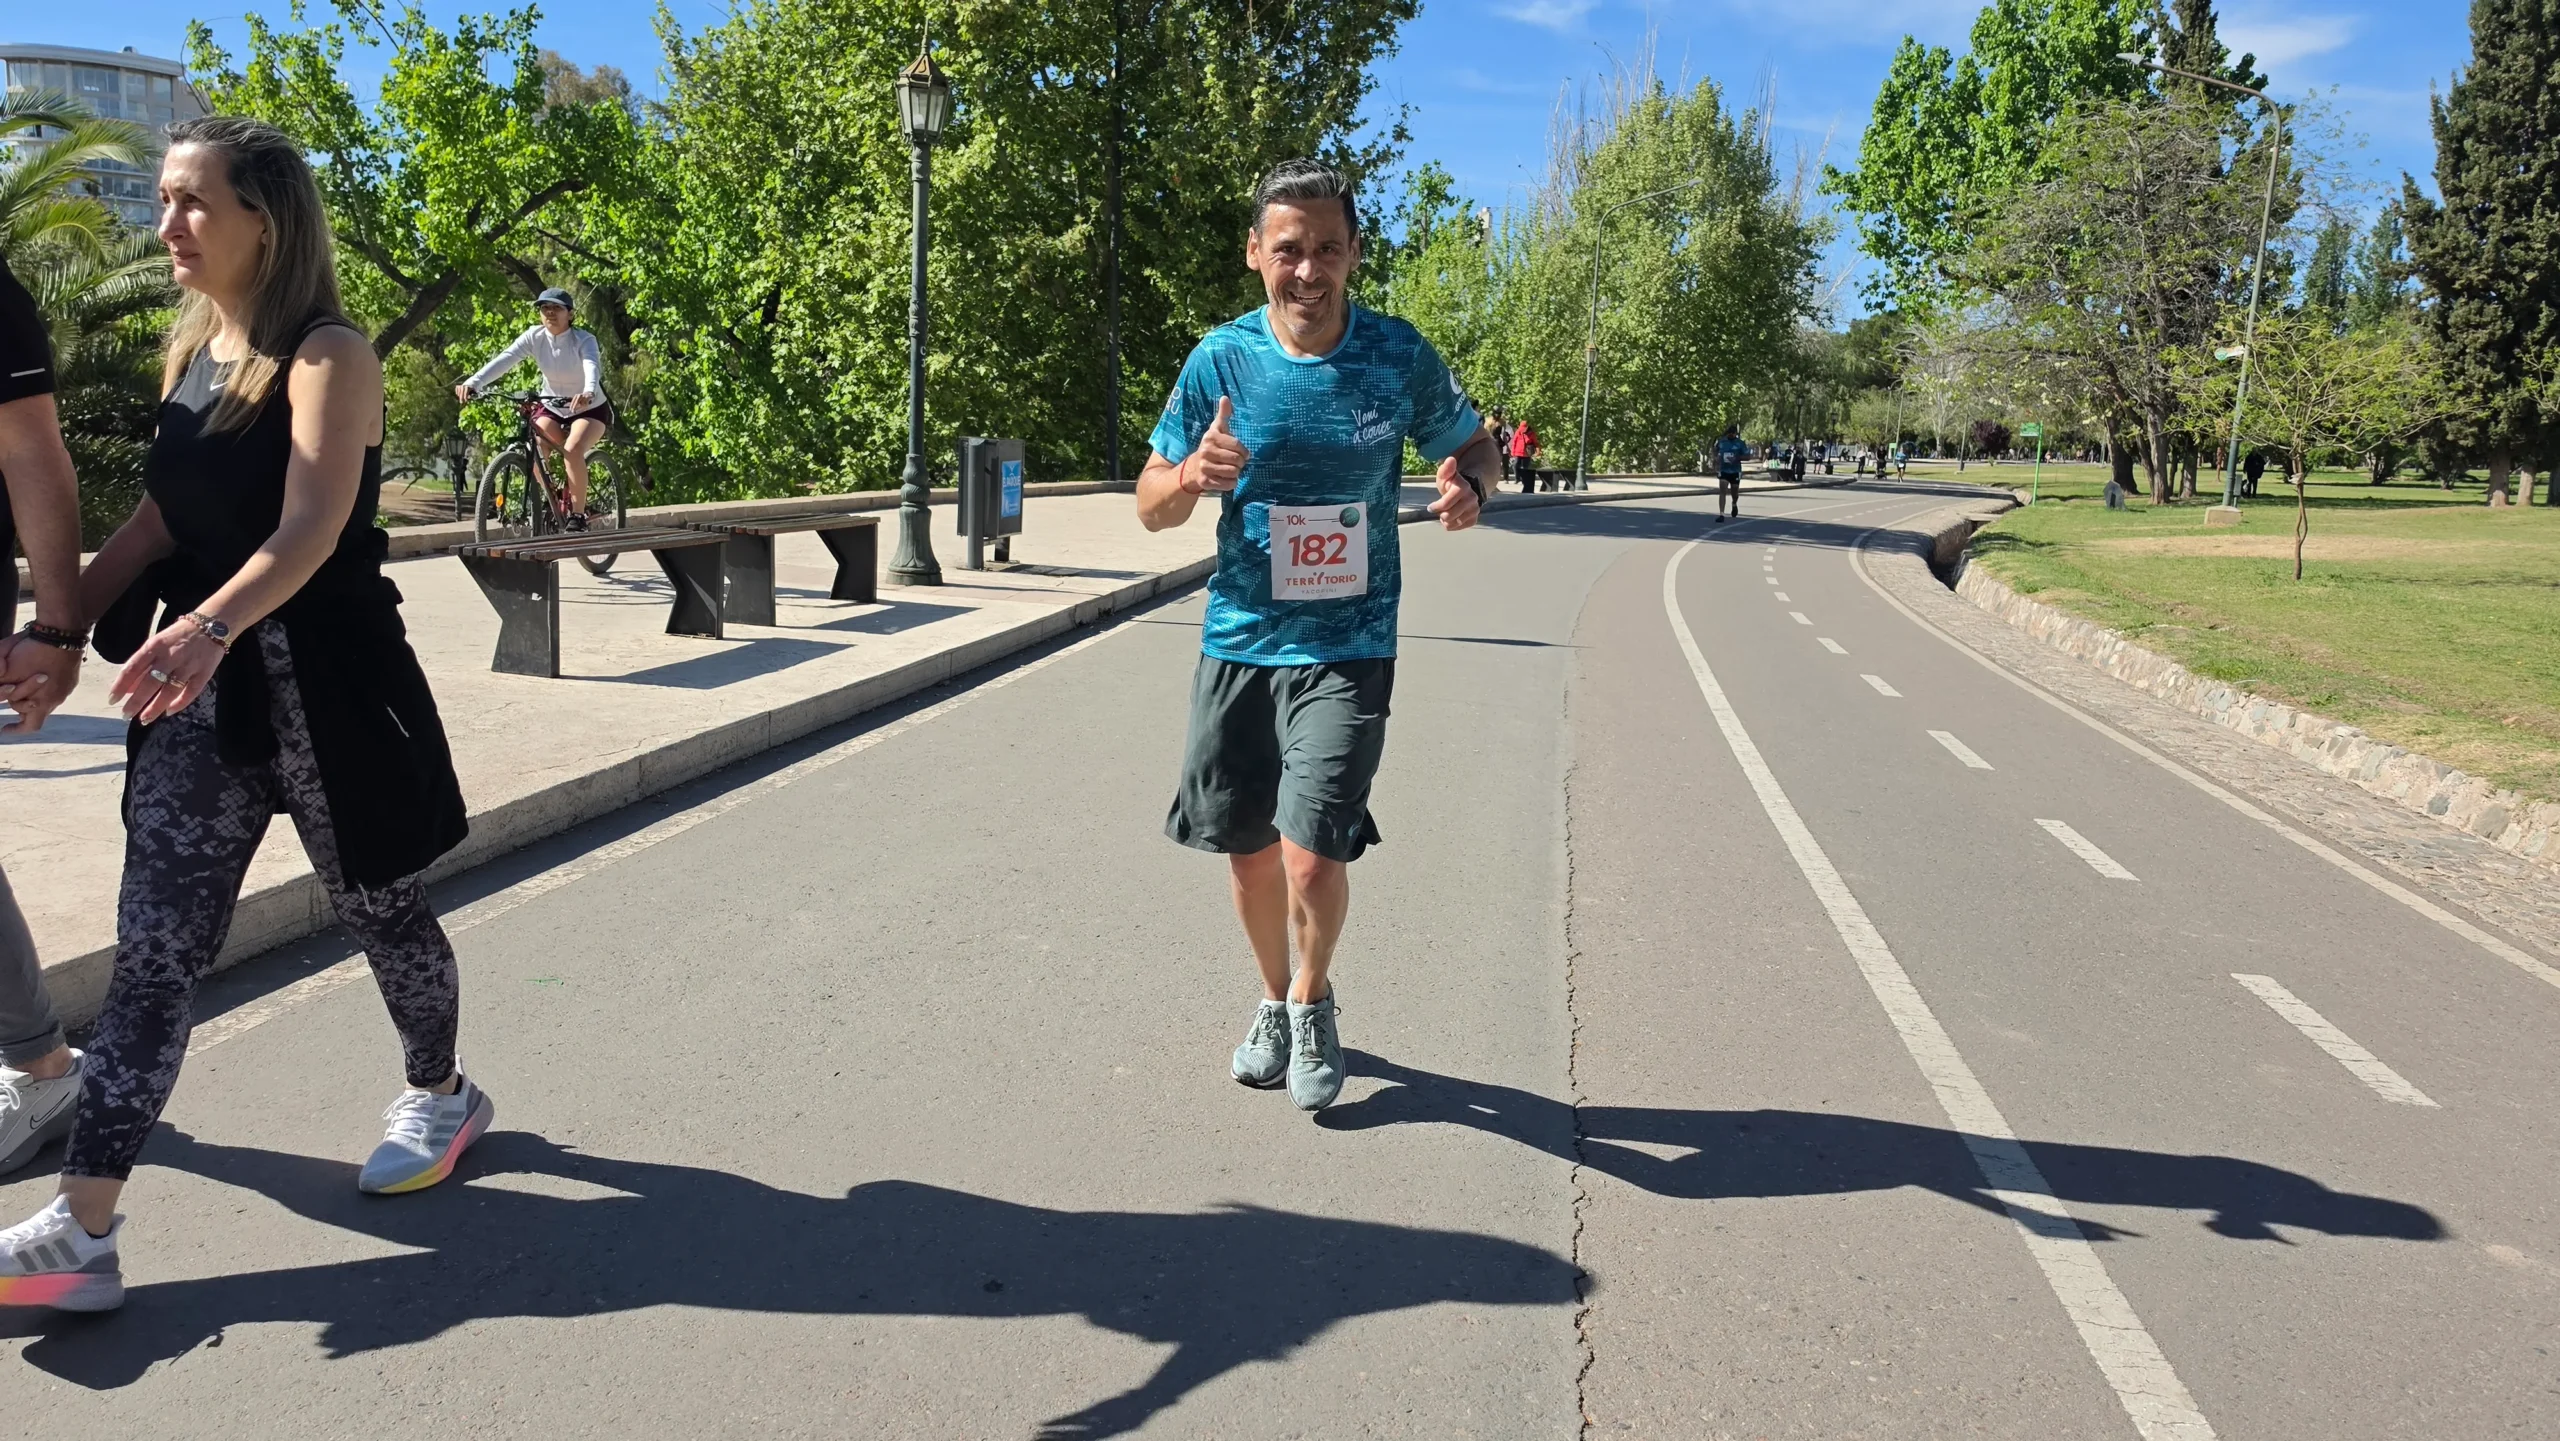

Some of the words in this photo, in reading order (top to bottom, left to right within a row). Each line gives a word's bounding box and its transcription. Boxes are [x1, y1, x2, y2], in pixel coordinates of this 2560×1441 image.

[1351, 401, 1379, 427] Vení
[1286, 514, 1307, 526] 10k
[1288, 532, 1348, 567] 182
[1285, 571, 1358, 586] TERRITORIO
